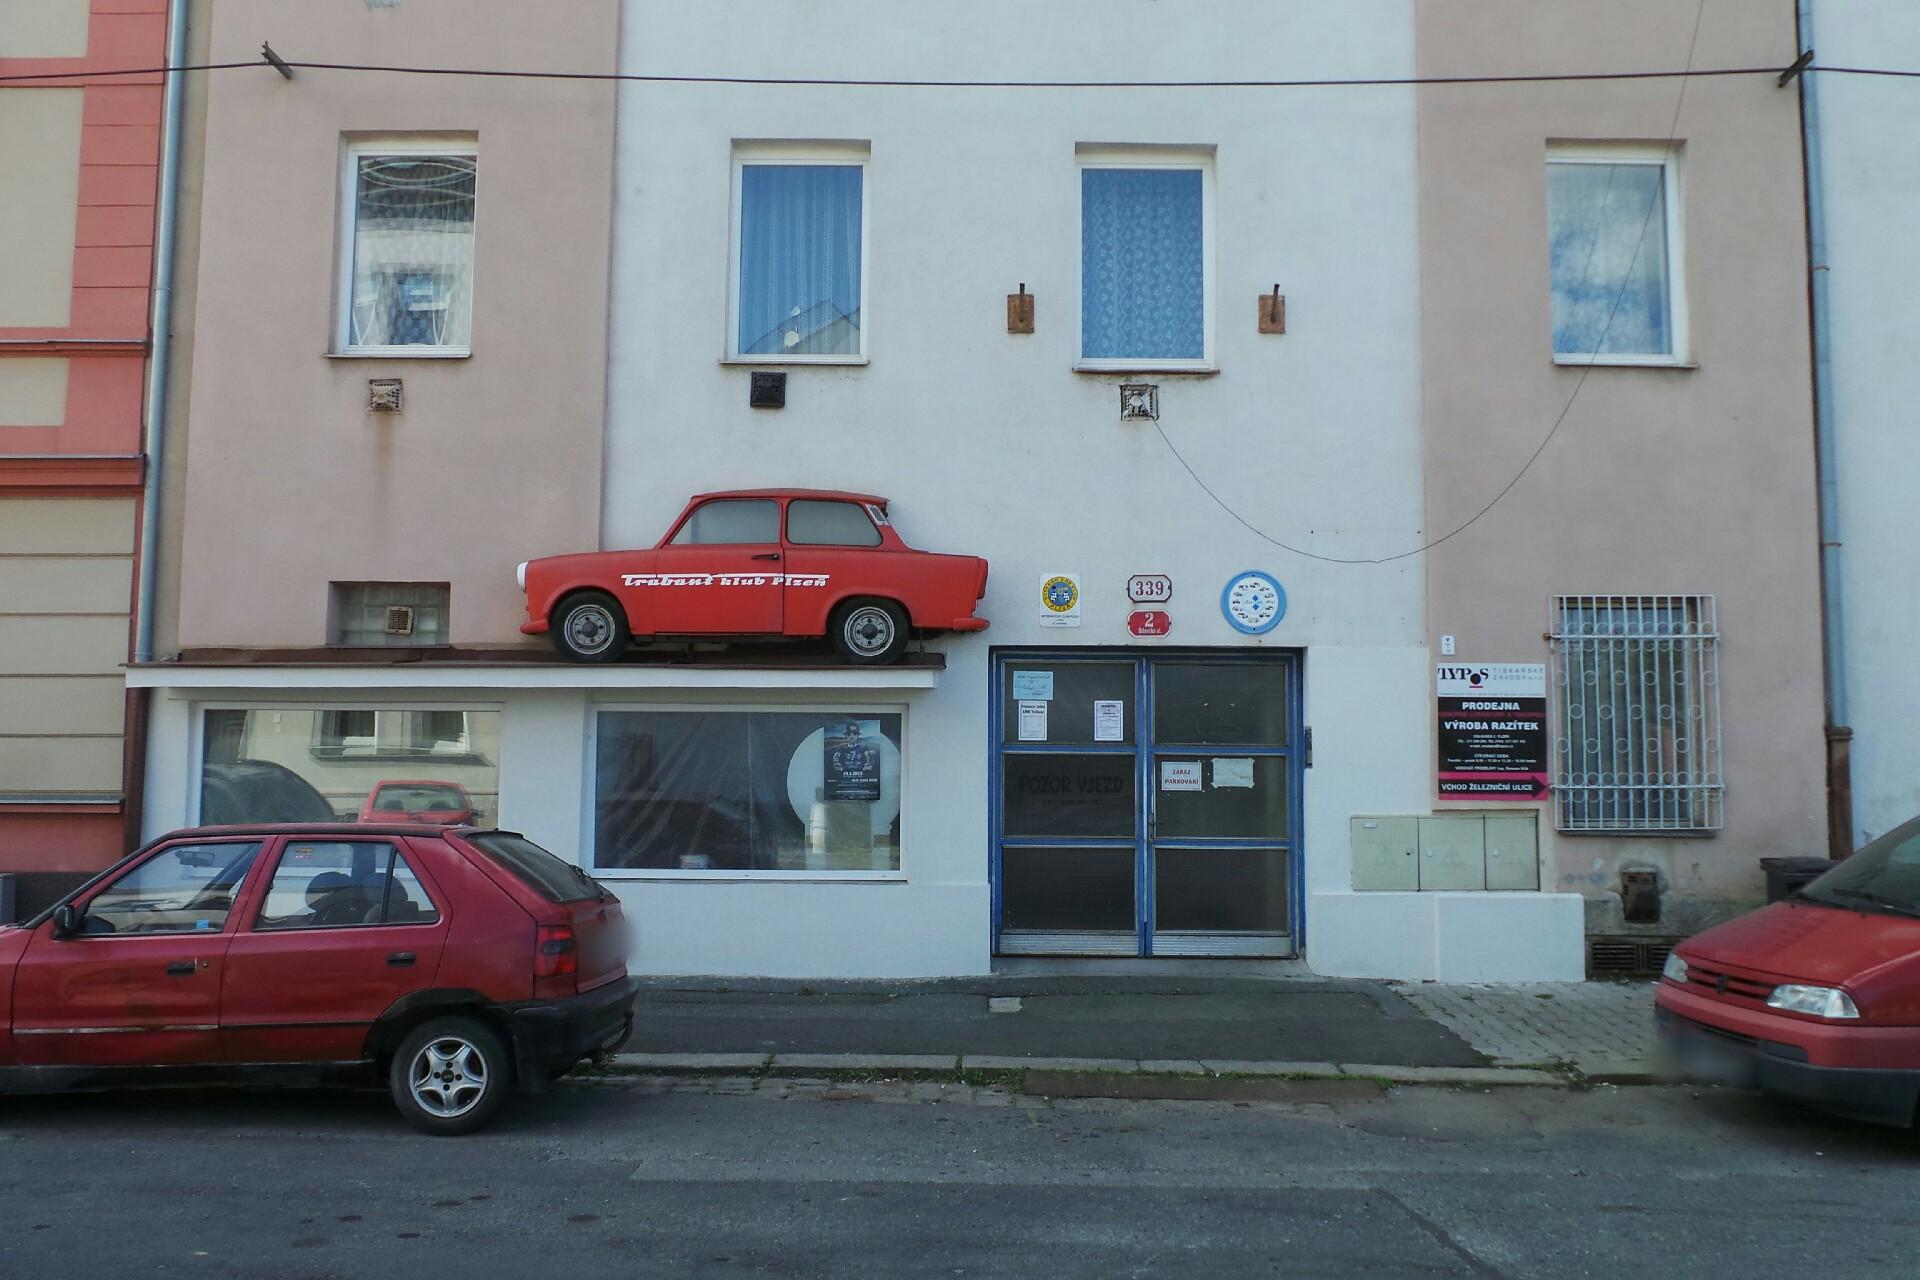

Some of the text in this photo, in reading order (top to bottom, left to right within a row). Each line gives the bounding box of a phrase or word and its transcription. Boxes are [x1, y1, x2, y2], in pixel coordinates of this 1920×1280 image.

[719, 576, 765, 586] klub
[1135, 581, 1164, 596] 339
[1144, 612, 1154, 628] 2
[1461, 701, 1521, 711] PRODEJNA
[1444, 719, 1539, 731] VÝROBA RAZÍTEK
[1077, 776, 1124, 794] VJEZD
[1441, 783, 1468, 791] VCHOD
[1468, 782, 1511, 791] ŽELEZNIČNÍ
